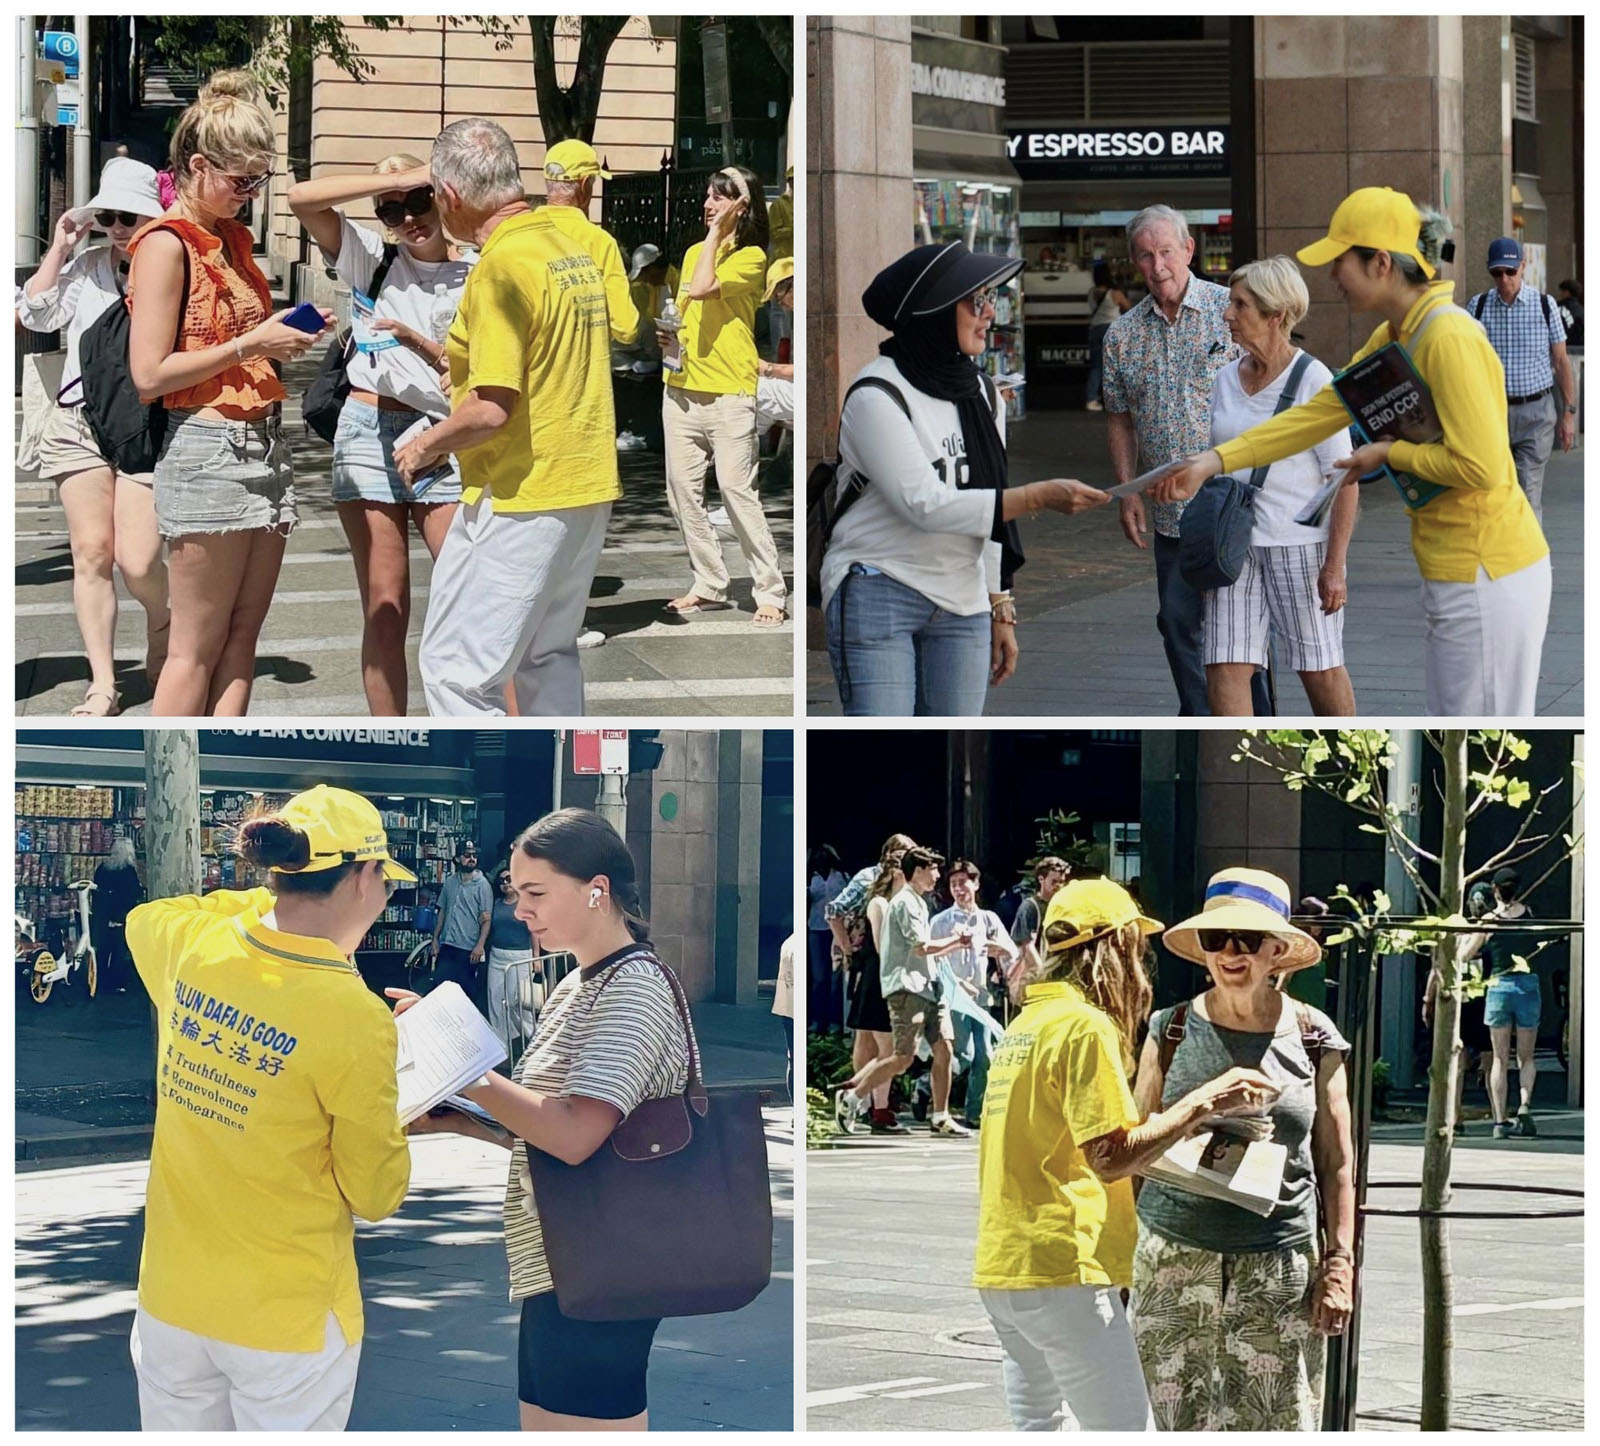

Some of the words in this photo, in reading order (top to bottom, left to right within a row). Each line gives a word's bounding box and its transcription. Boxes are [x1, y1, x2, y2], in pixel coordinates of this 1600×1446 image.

[62, 39, 72, 52] B
[1007, 135, 1022, 157] Y
[1028, 132, 1165, 157] ESPRESSO
[1171, 131, 1224, 155] BAR
[1367, 408, 1395, 431] END
[1394, 391, 1420, 415] CCP
[300, 729, 430, 747] CONVENIENCE
[203, 997, 240, 1030] DAFA
[236, 1013, 255, 1036] IS
[252, 1021, 297, 1056] GOOD
[176, 1052, 257, 1098] Truthfulness
